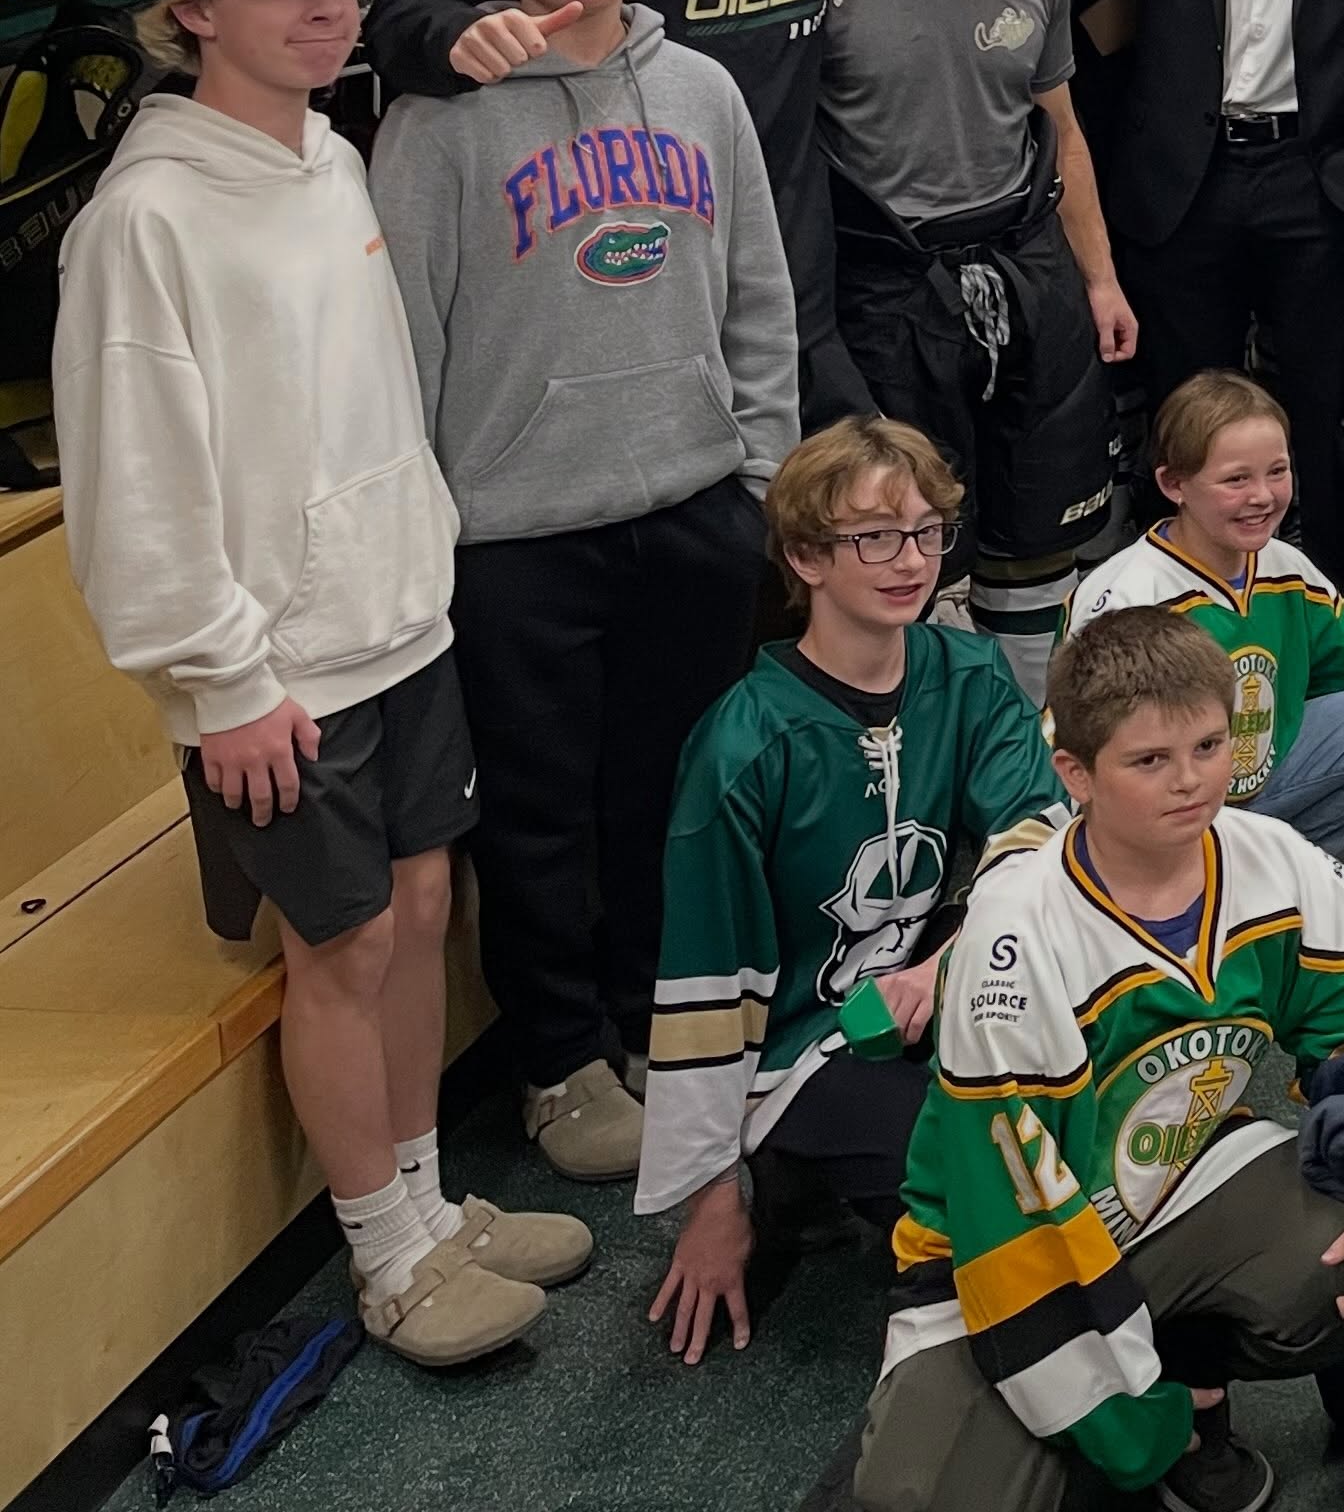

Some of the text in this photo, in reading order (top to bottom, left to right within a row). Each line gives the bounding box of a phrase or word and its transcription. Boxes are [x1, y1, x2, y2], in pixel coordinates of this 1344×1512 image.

[504, 123, 716, 264] FLORIDA
[970, 992, 1027, 1012] SOURCE
[989, 1102, 1081, 1215] 12
